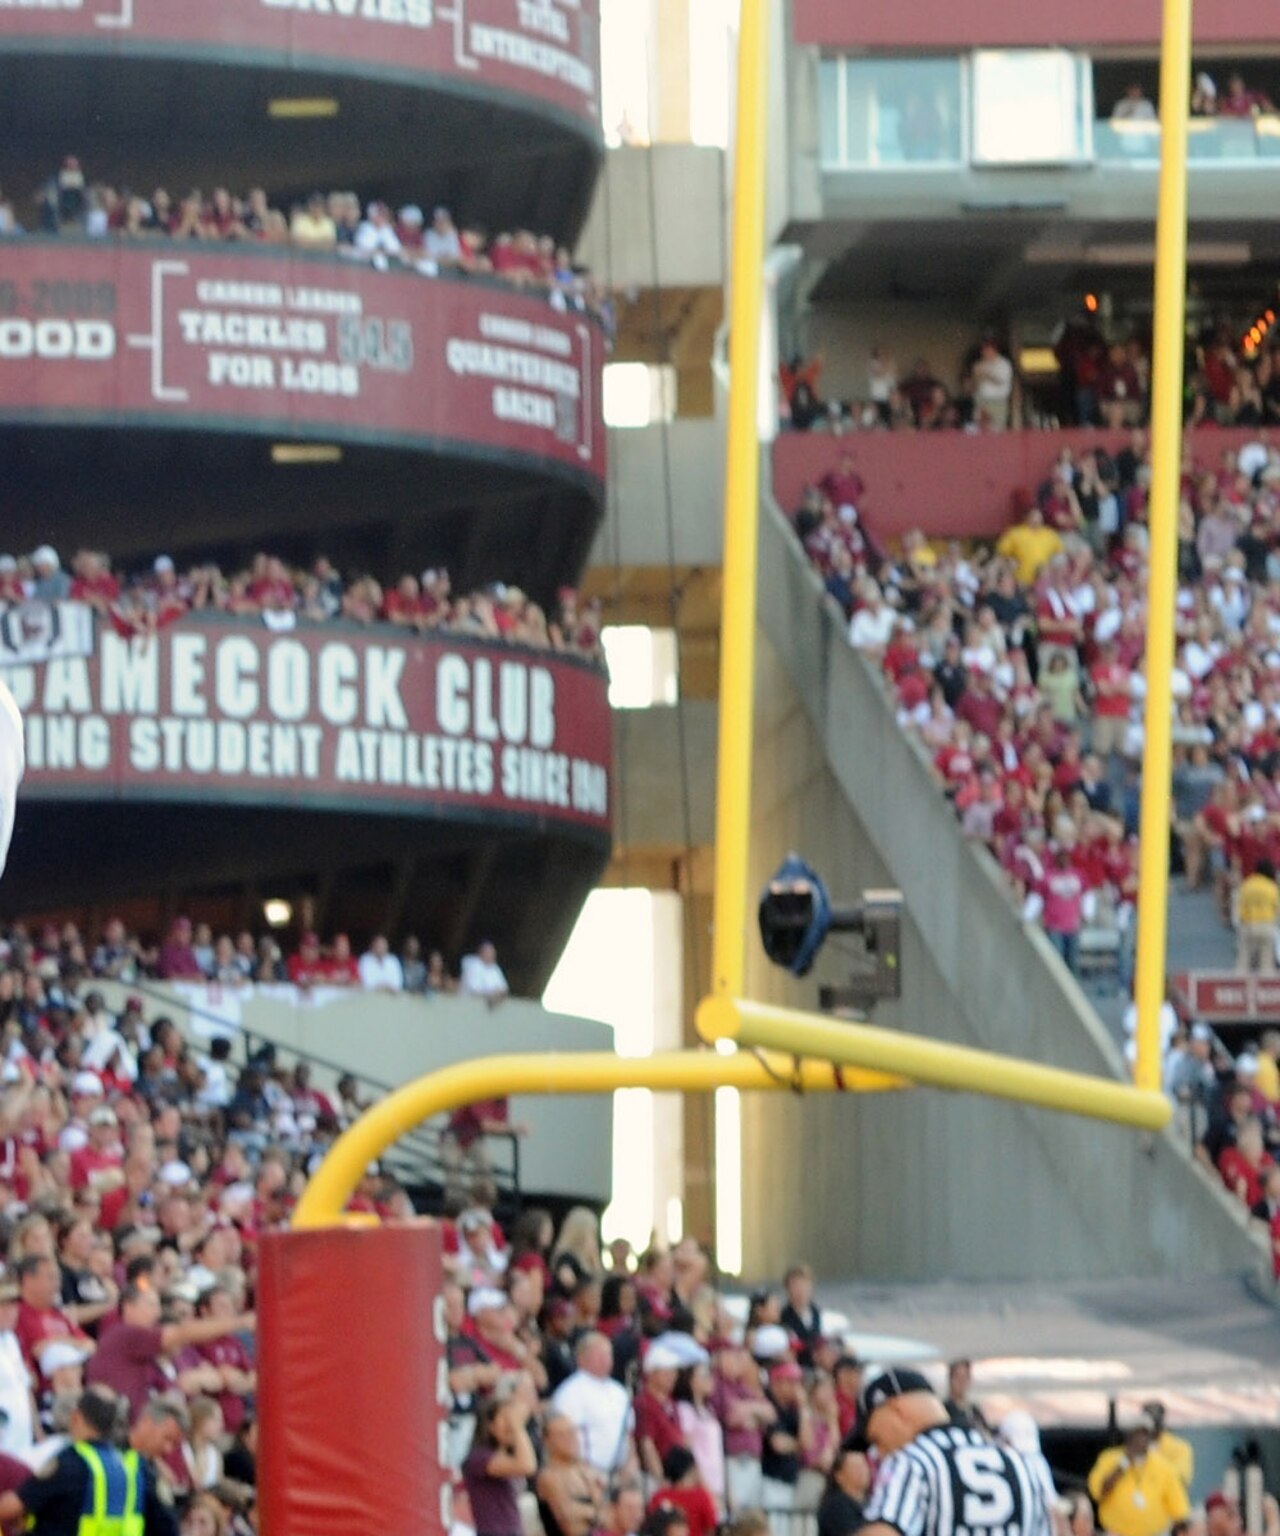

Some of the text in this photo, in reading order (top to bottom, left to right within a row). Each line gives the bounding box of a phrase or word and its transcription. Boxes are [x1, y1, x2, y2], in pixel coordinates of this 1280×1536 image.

[179, 309, 327, 354] TACKLES
[208, 351, 359, 397] FOR LOSS
[436, 652, 555, 750] CLUB
[129, 716, 322, 780] STUDENT
[336, 725, 494, 796] ATHLETES
[953, 1446, 1016, 1527] S
